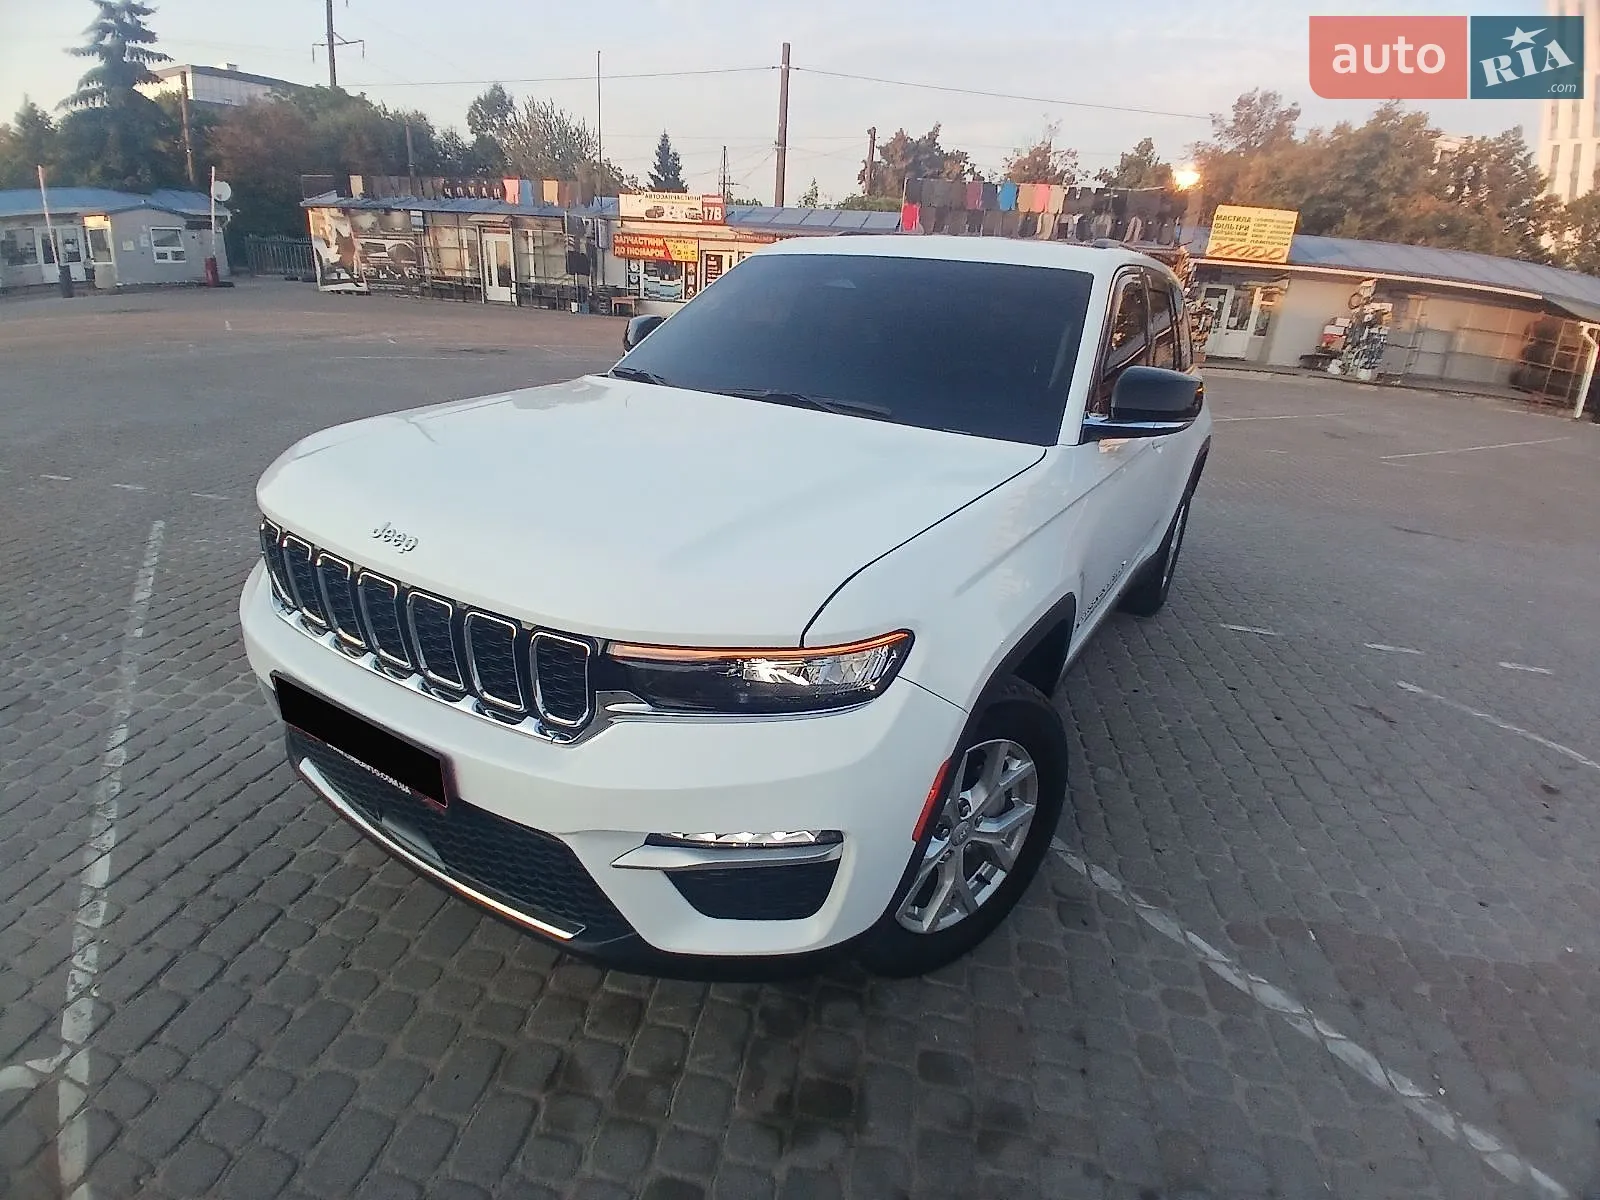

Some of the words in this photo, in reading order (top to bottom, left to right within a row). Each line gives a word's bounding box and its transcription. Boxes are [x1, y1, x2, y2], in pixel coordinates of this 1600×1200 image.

[1215, 214, 1251, 223] МАСТИЛА
[1214, 222, 1250, 231] ФІЛЬТРИ
[614, 235, 665, 248] ЗАПЧАСТИНИ
[614, 246, 626, 256] ДО
[372, 522, 419, 554] Jeep
